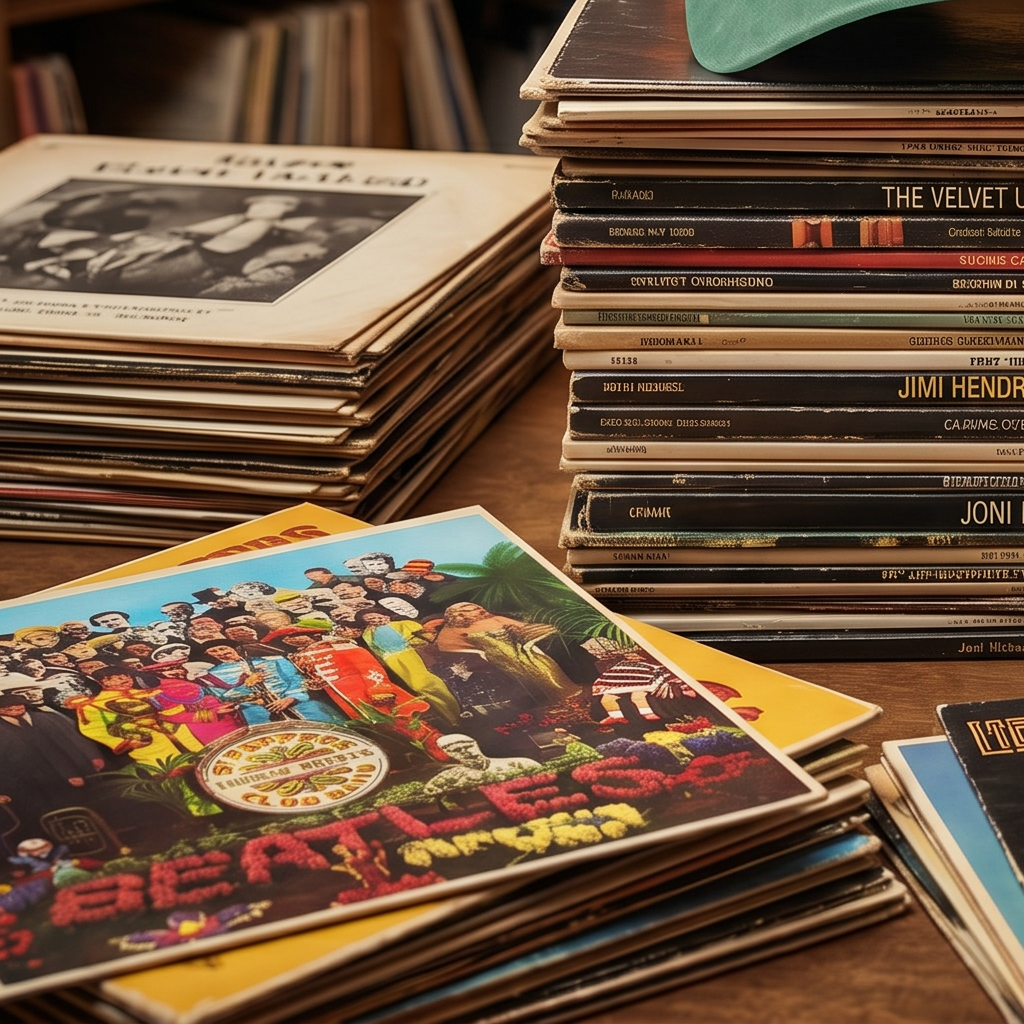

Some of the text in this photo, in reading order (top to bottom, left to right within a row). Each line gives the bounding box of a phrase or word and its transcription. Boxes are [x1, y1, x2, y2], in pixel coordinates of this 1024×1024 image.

[881, 186, 924, 209] THE
[931, 186, 1008, 209] VELVET
[898, 376, 944, 399] JIMI
[960, 500, 1012, 525] JONI
